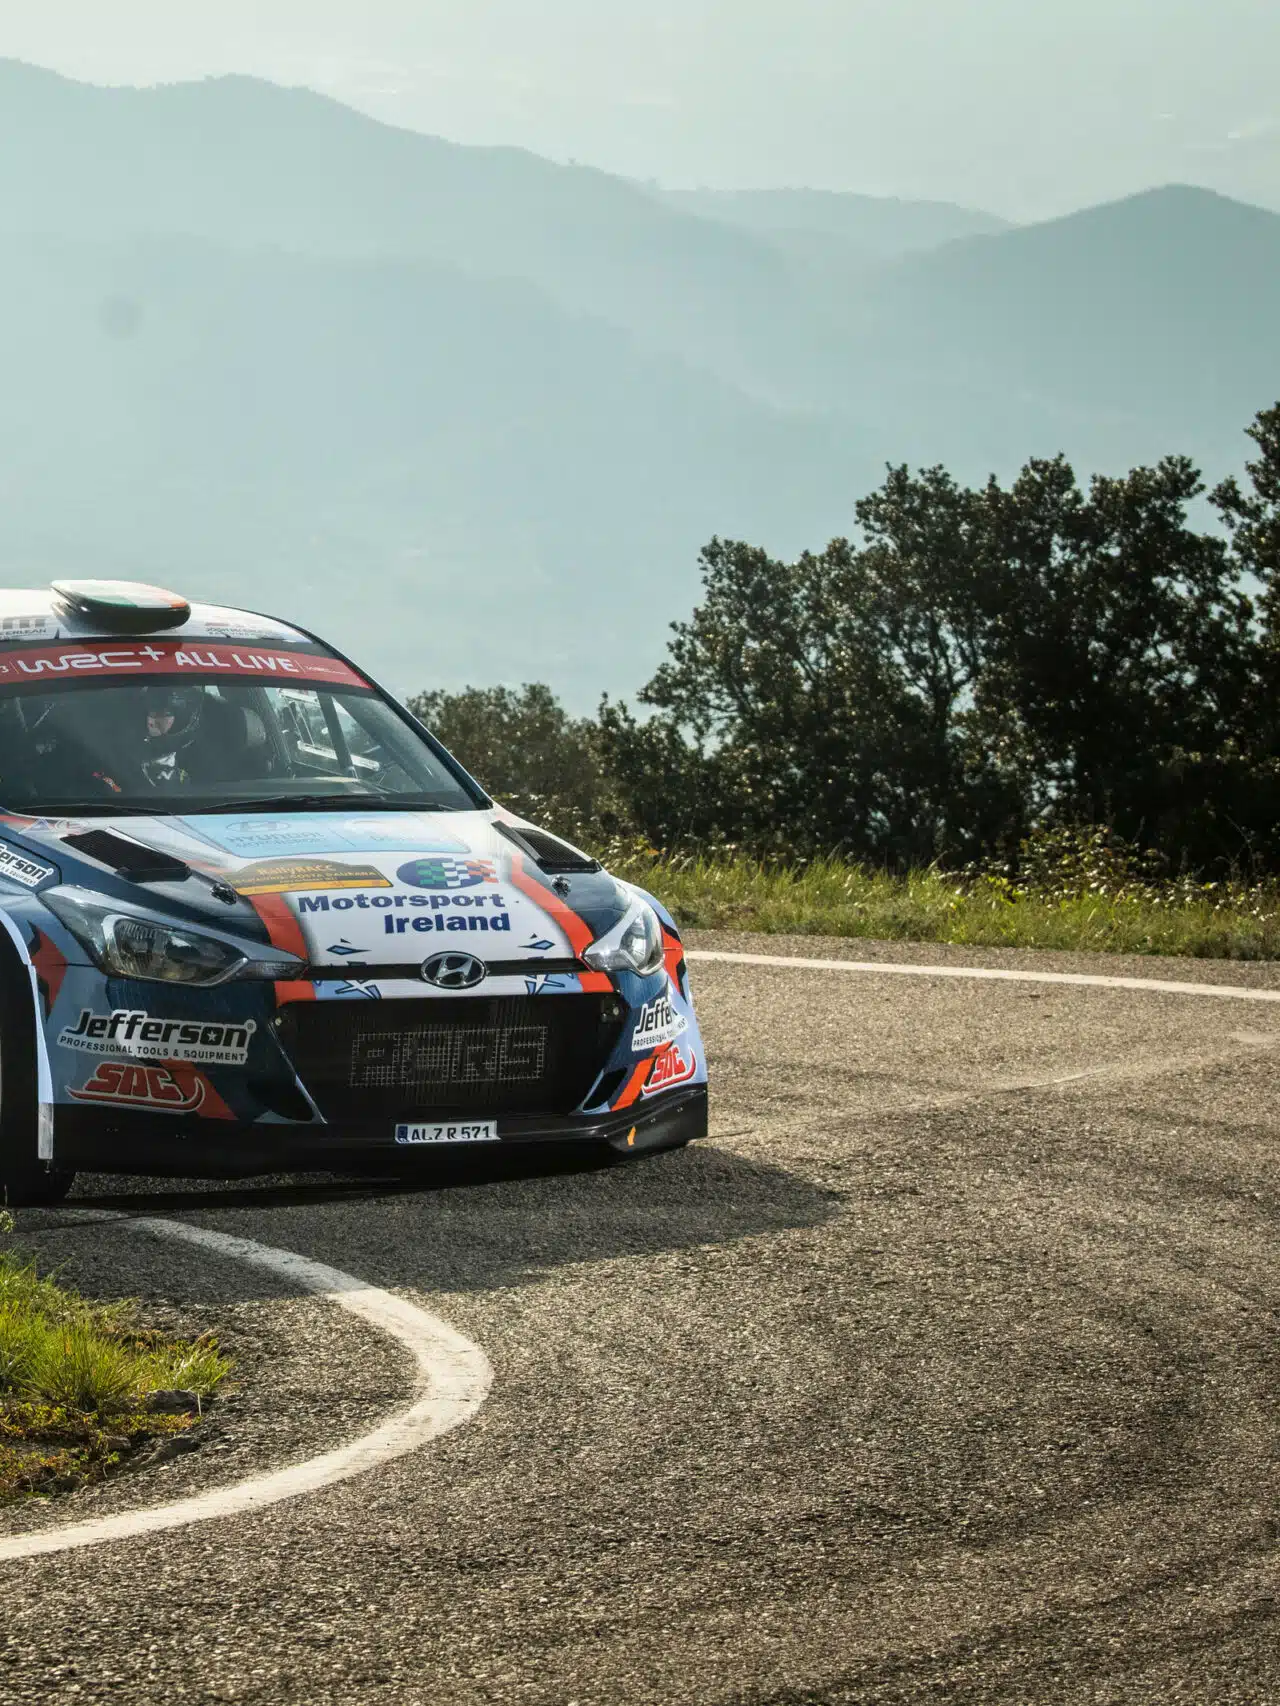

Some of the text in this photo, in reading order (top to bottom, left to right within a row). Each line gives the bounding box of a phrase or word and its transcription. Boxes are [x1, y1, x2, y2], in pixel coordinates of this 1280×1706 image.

[0, 665, 9, 674] 3
[175, 651, 231, 668] ALL
[232, 653, 299, 673] LIVE
[297, 893, 506, 913] Motorsport
[384, 913, 511, 934] Ireland
[65, 1010, 249, 1048] Jefferson
[60, 1036, 133, 1054] PROFESSIONAL
[137, 1046, 170, 1056] TOOLS
[173, 1049, 179, 1057] &
[447, 1127, 458, 1140] R
[461, 1126, 491, 1139] 571
